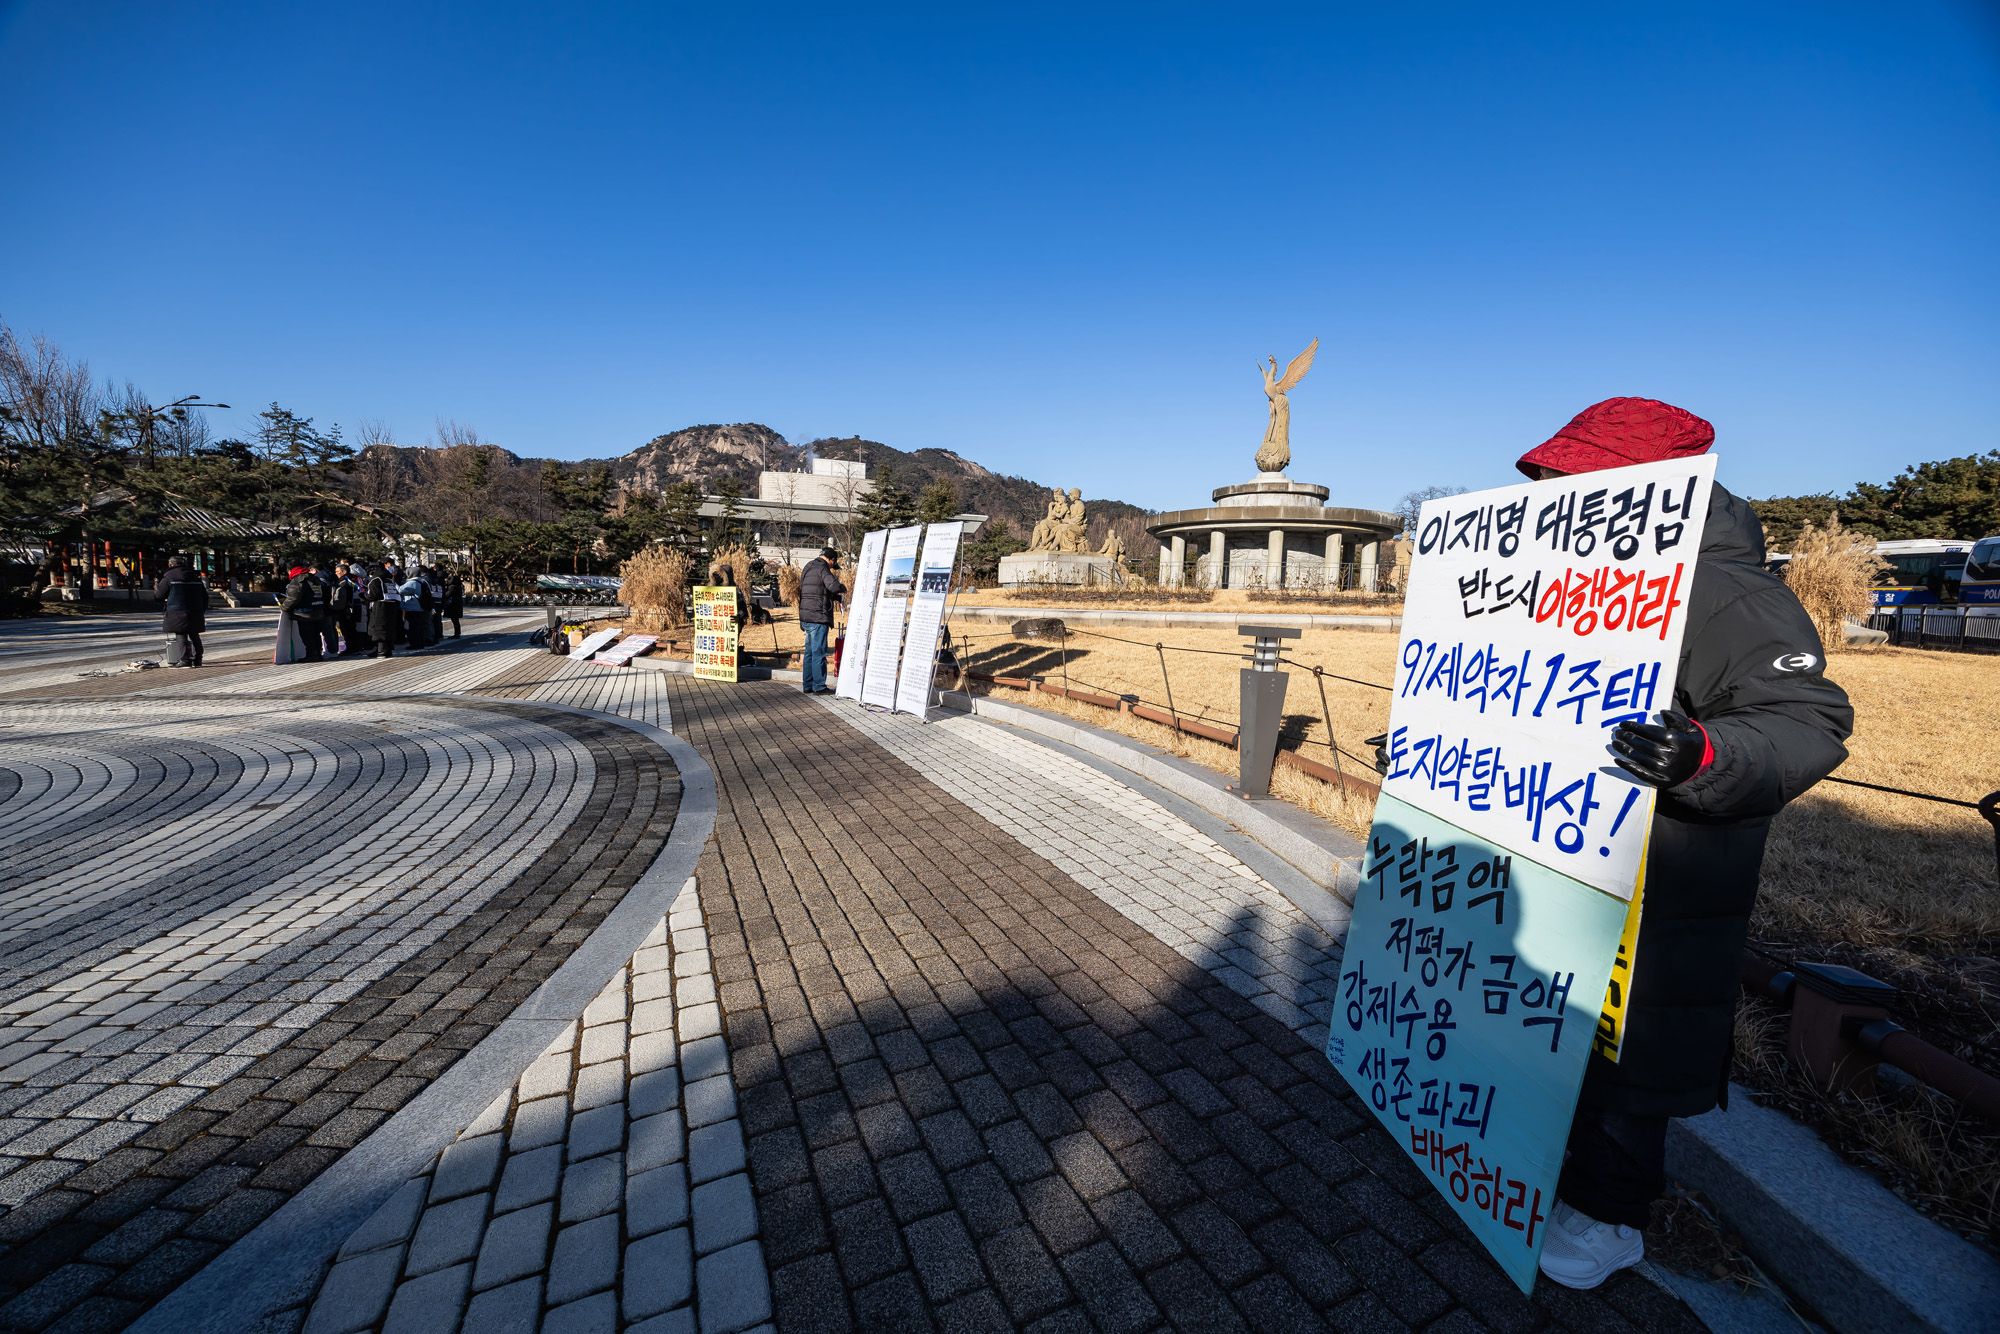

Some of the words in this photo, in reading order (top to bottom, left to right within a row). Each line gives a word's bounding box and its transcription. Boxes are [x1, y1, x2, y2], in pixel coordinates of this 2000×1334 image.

[1418, 495, 1529, 559] 이재명
[1535, 475, 1698, 561] 대통령님
[1458, 567, 1541, 619] 반드시
[1535, 562, 1685, 641] 이행하라
[1343, 960, 1457, 1062] 강제수용
[1482, 954, 1575, 1053] 금액
[1410, 1124, 1544, 1249] 배상하라
